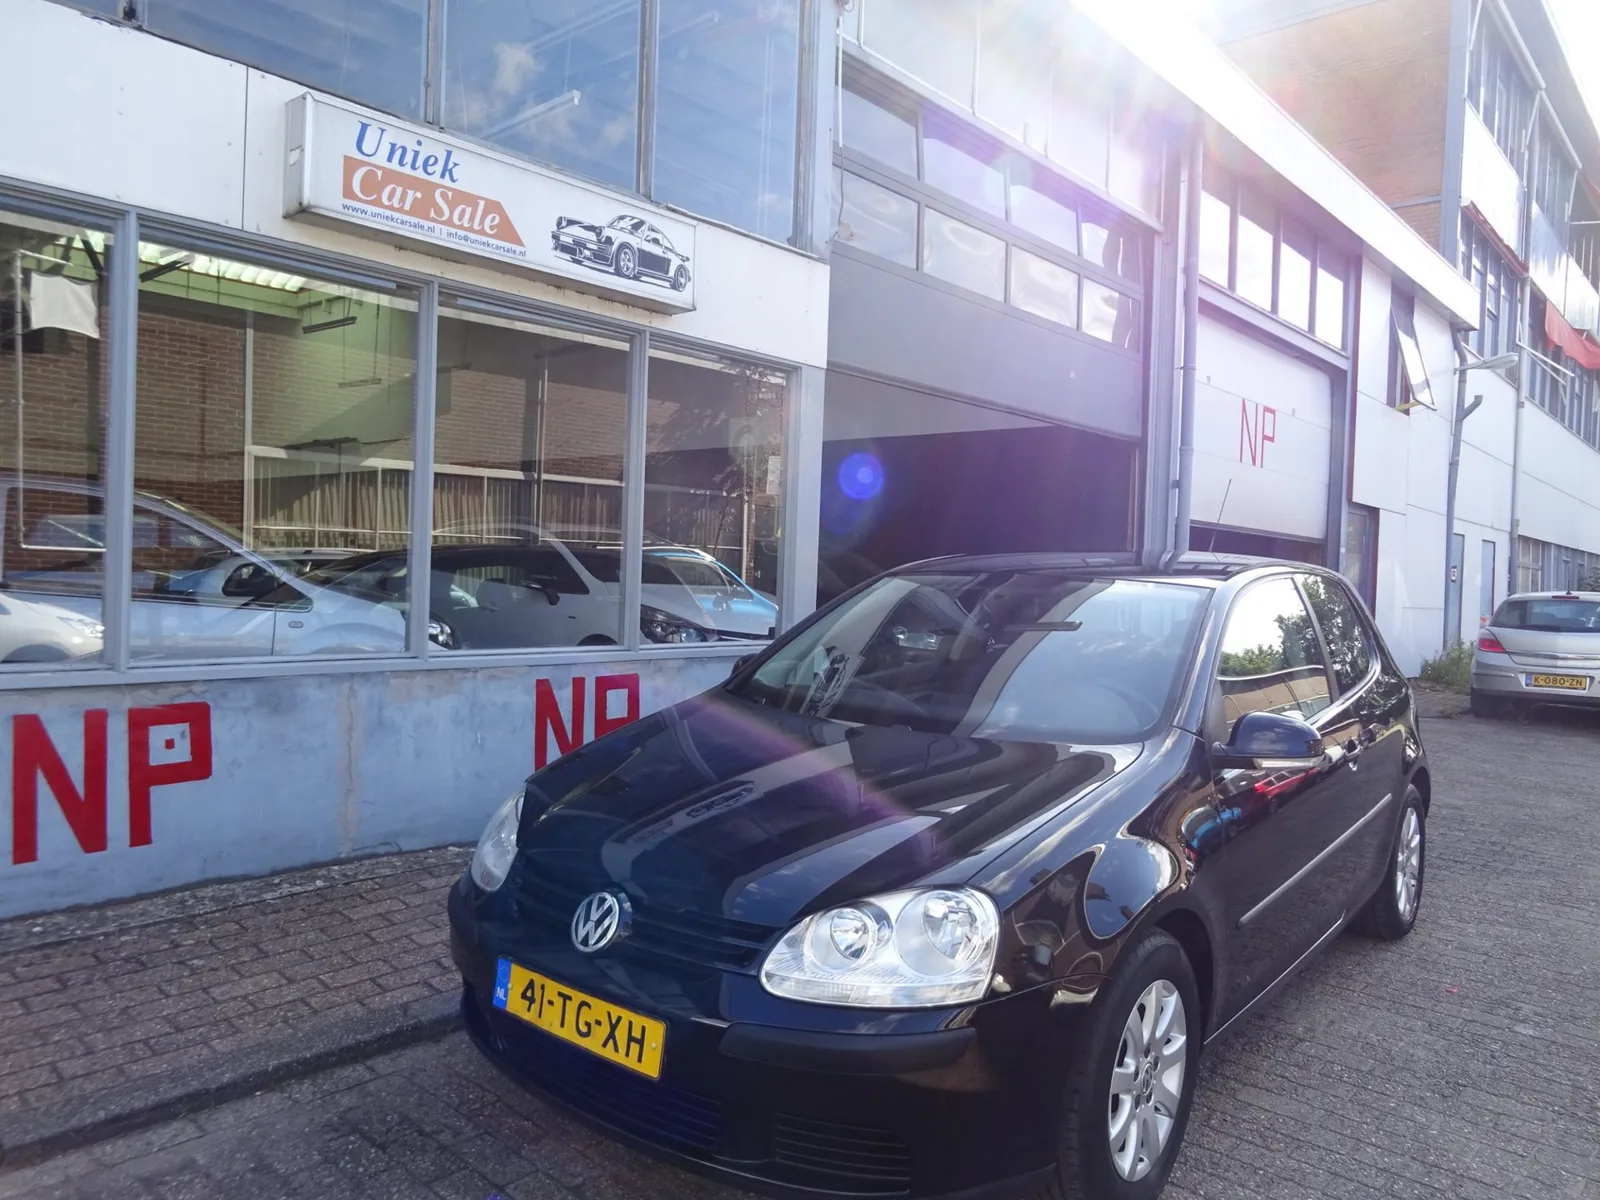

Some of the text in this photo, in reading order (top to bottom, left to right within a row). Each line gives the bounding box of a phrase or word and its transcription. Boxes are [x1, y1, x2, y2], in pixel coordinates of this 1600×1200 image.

[356, 121, 460, 183] Uniek
[342, 203, 527, 258] www.uniekcarsale.nl info@uniekcarsale.nl
[351, 166, 501, 235] Car Sale
[1240, 398, 1276, 468] NP
[1533, 676, 1583, 687] K-080-ZN
[535, 672, 640, 772] NP
[12, 701, 213, 865] NP
[521, 978, 647, 1064] 41-TG-XH
